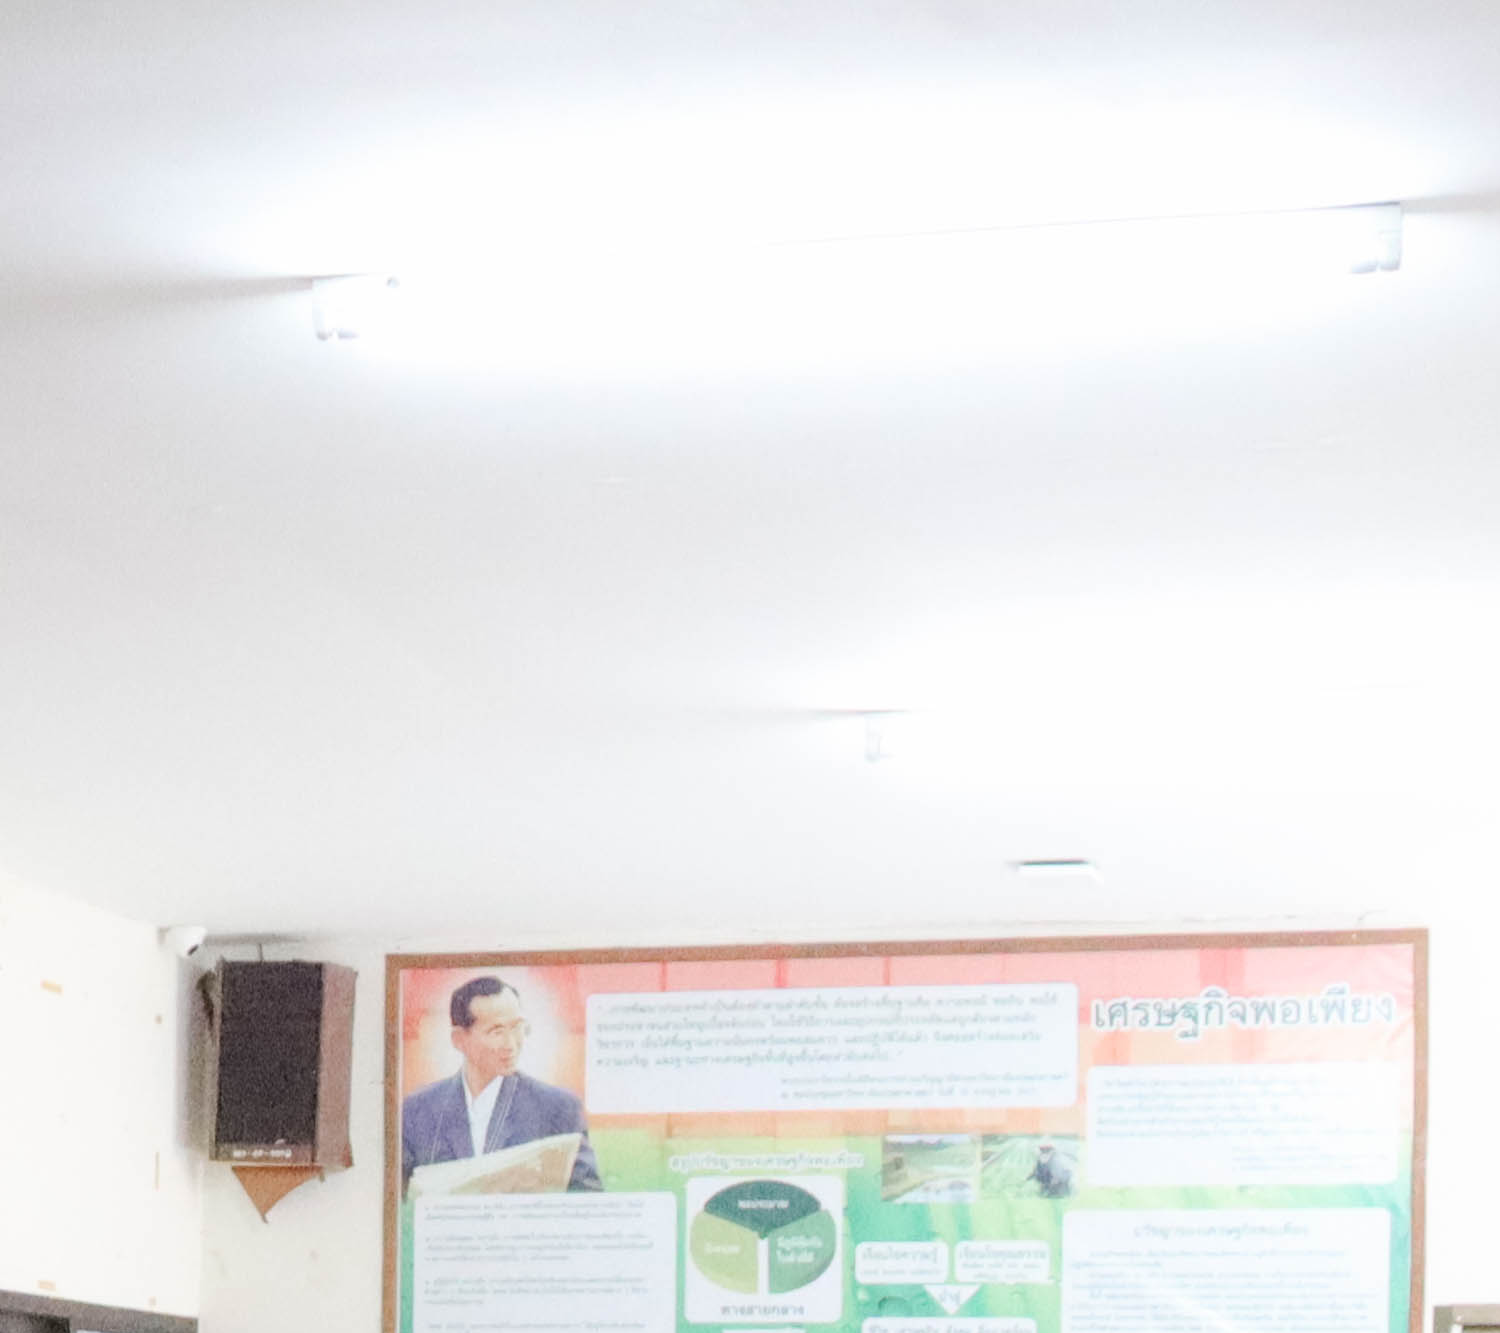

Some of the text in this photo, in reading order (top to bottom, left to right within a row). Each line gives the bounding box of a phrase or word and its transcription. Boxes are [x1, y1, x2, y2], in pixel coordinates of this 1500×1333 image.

[1094, 987, 1393, 1039] เศรษฐกิจพอเพียง
